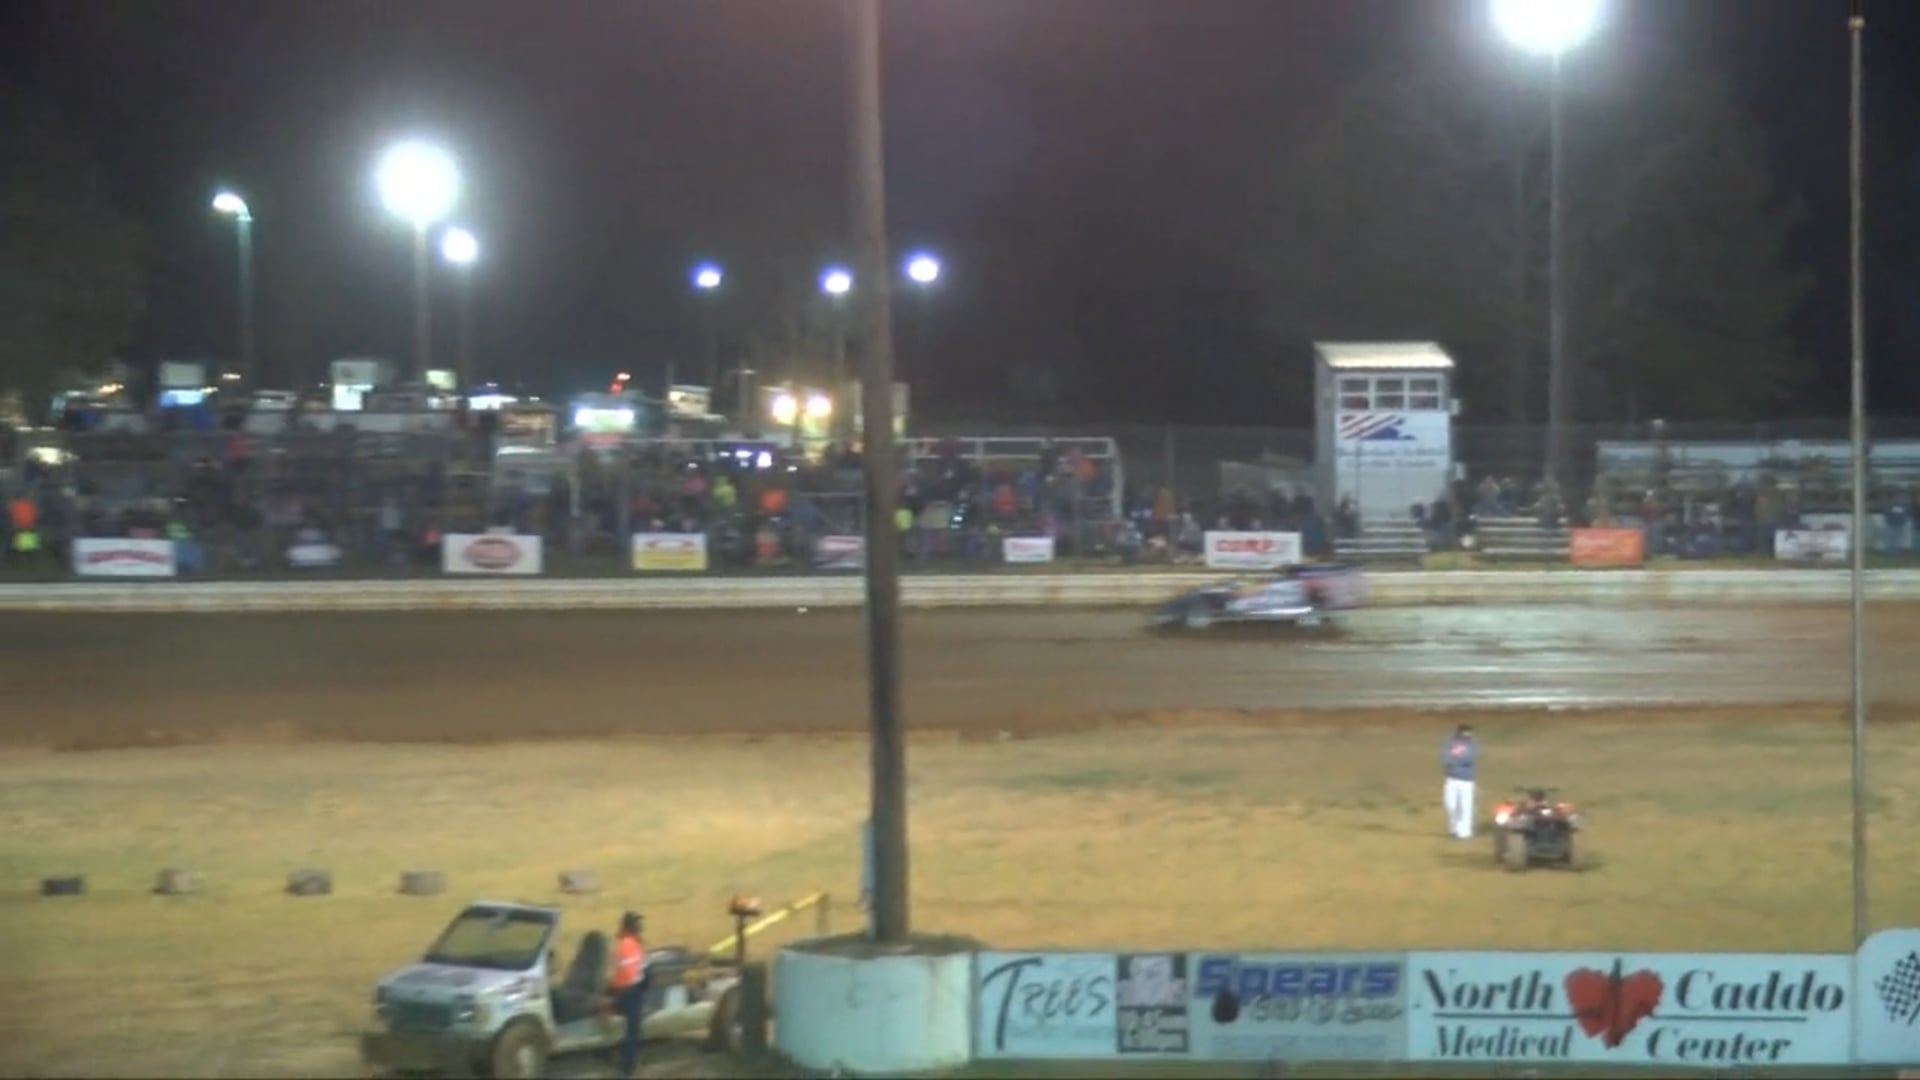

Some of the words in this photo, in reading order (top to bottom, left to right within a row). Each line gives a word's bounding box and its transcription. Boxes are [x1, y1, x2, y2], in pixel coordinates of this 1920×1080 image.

[1195, 958, 1398, 1005] Spears
[1414, 968, 1553, 1010] North
[1675, 968, 1844, 1012] Caddo
[1432, 1025, 1573, 1057] Medical
[1646, 1026, 1792, 1061] Center
